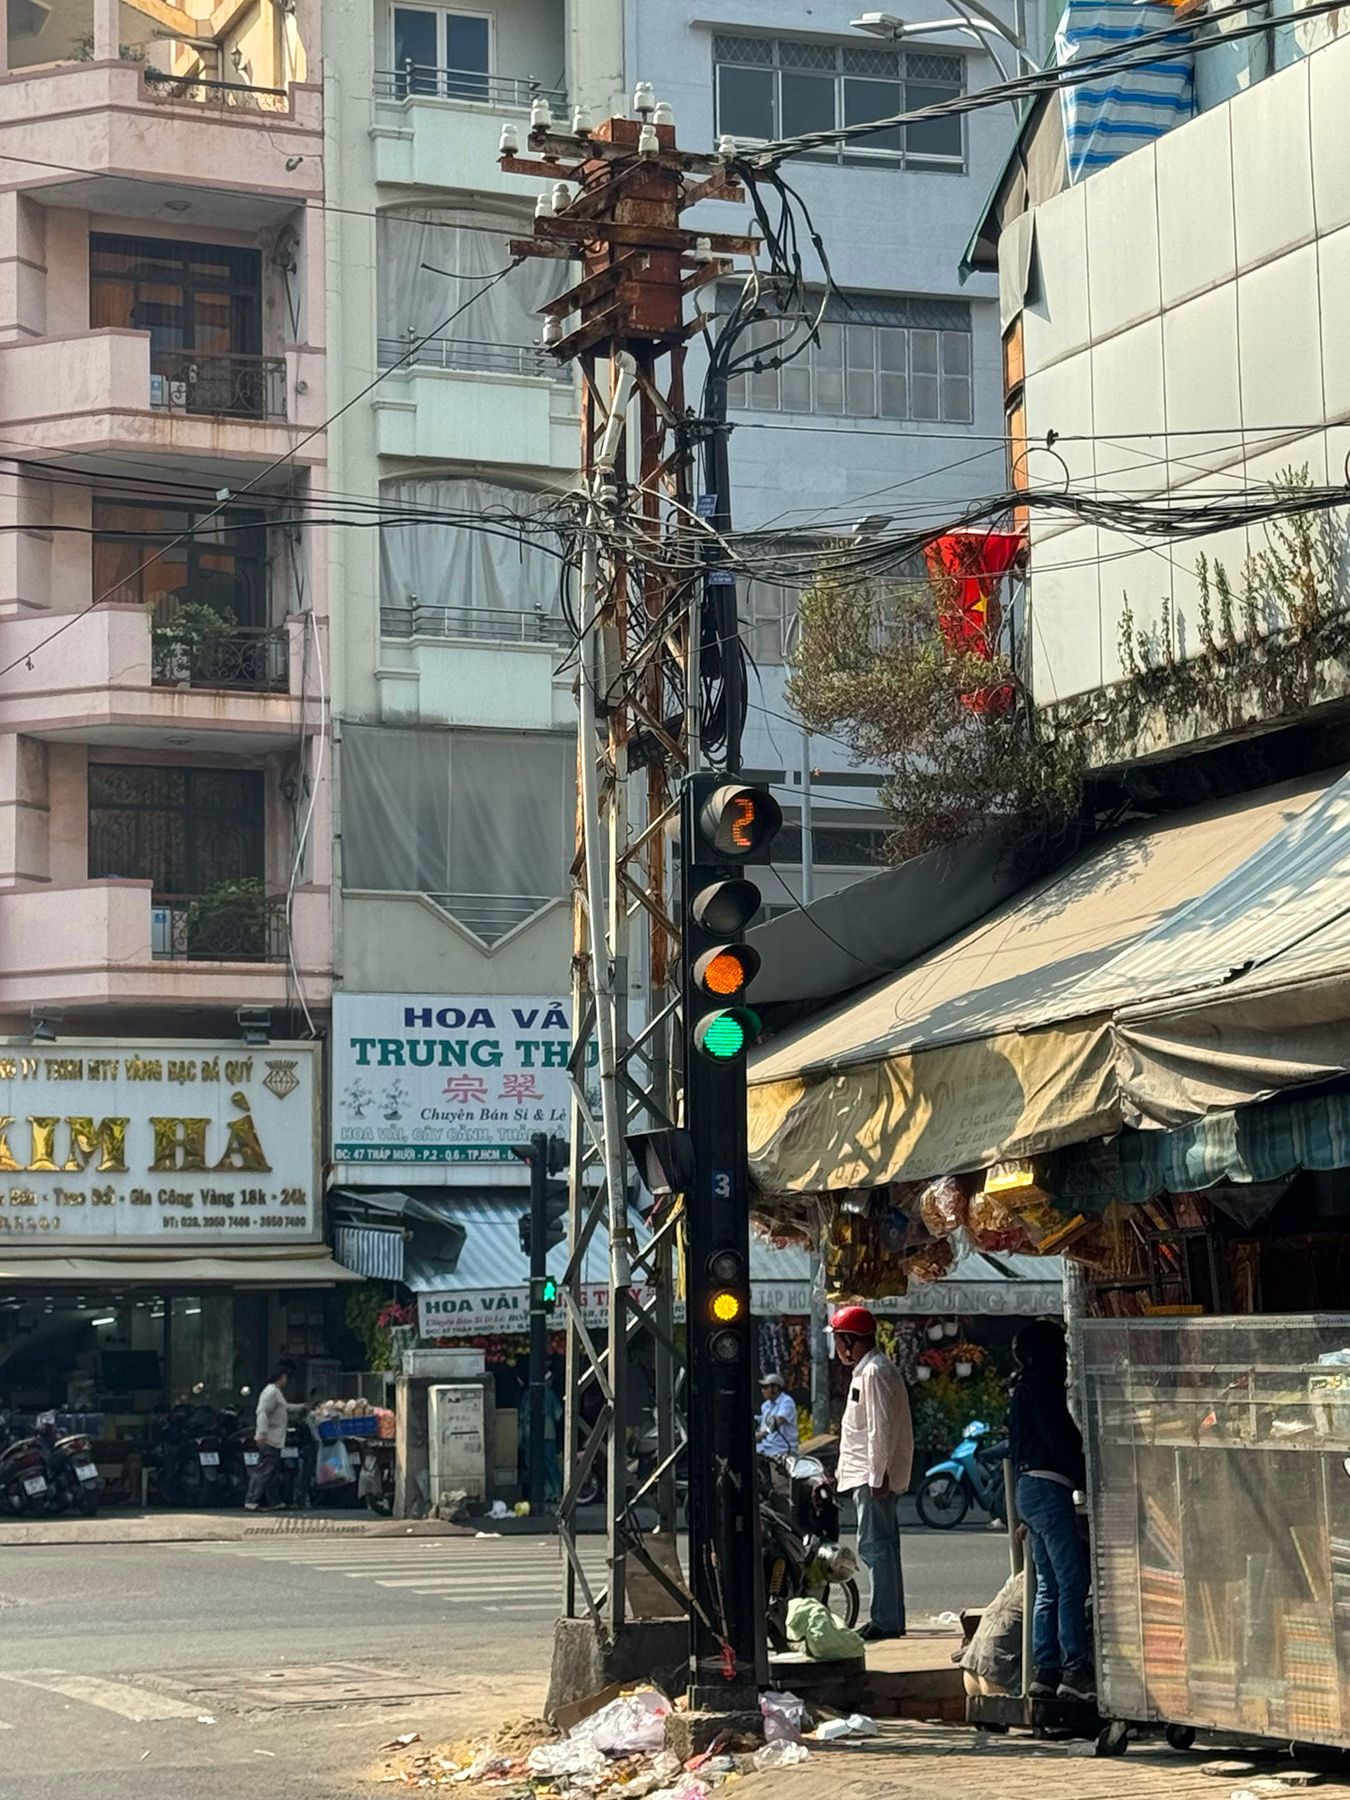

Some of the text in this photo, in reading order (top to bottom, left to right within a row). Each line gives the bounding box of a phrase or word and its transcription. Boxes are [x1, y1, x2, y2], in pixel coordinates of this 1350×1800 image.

[733, 798, 754, 846] 2
[404, 1002, 569, 1030] HOA VẢ
[350, 1038, 503, 1067] TRUNG
[167, 1060, 197, 1085] BẠC
[224, 1055, 254, 1085] QUÝ
[480, 1108, 508, 1120] Bán
[533, 1109, 544, 1120] &
[148, 1091, 272, 1172] HÀ
[341, 1127, 373, 1141] HOA
[353, 1149, 365, 1160] 47
[714, 1174, 730, 1198] 3
[157, 1188, 193, 1209] Công
[200, 1188, 235, 1208] Vàng
[240, 1189, 266, 1206] 18k
[425, 1299, 474, 1314] HOA
[480, 1293, 519, 1310] VẢI
